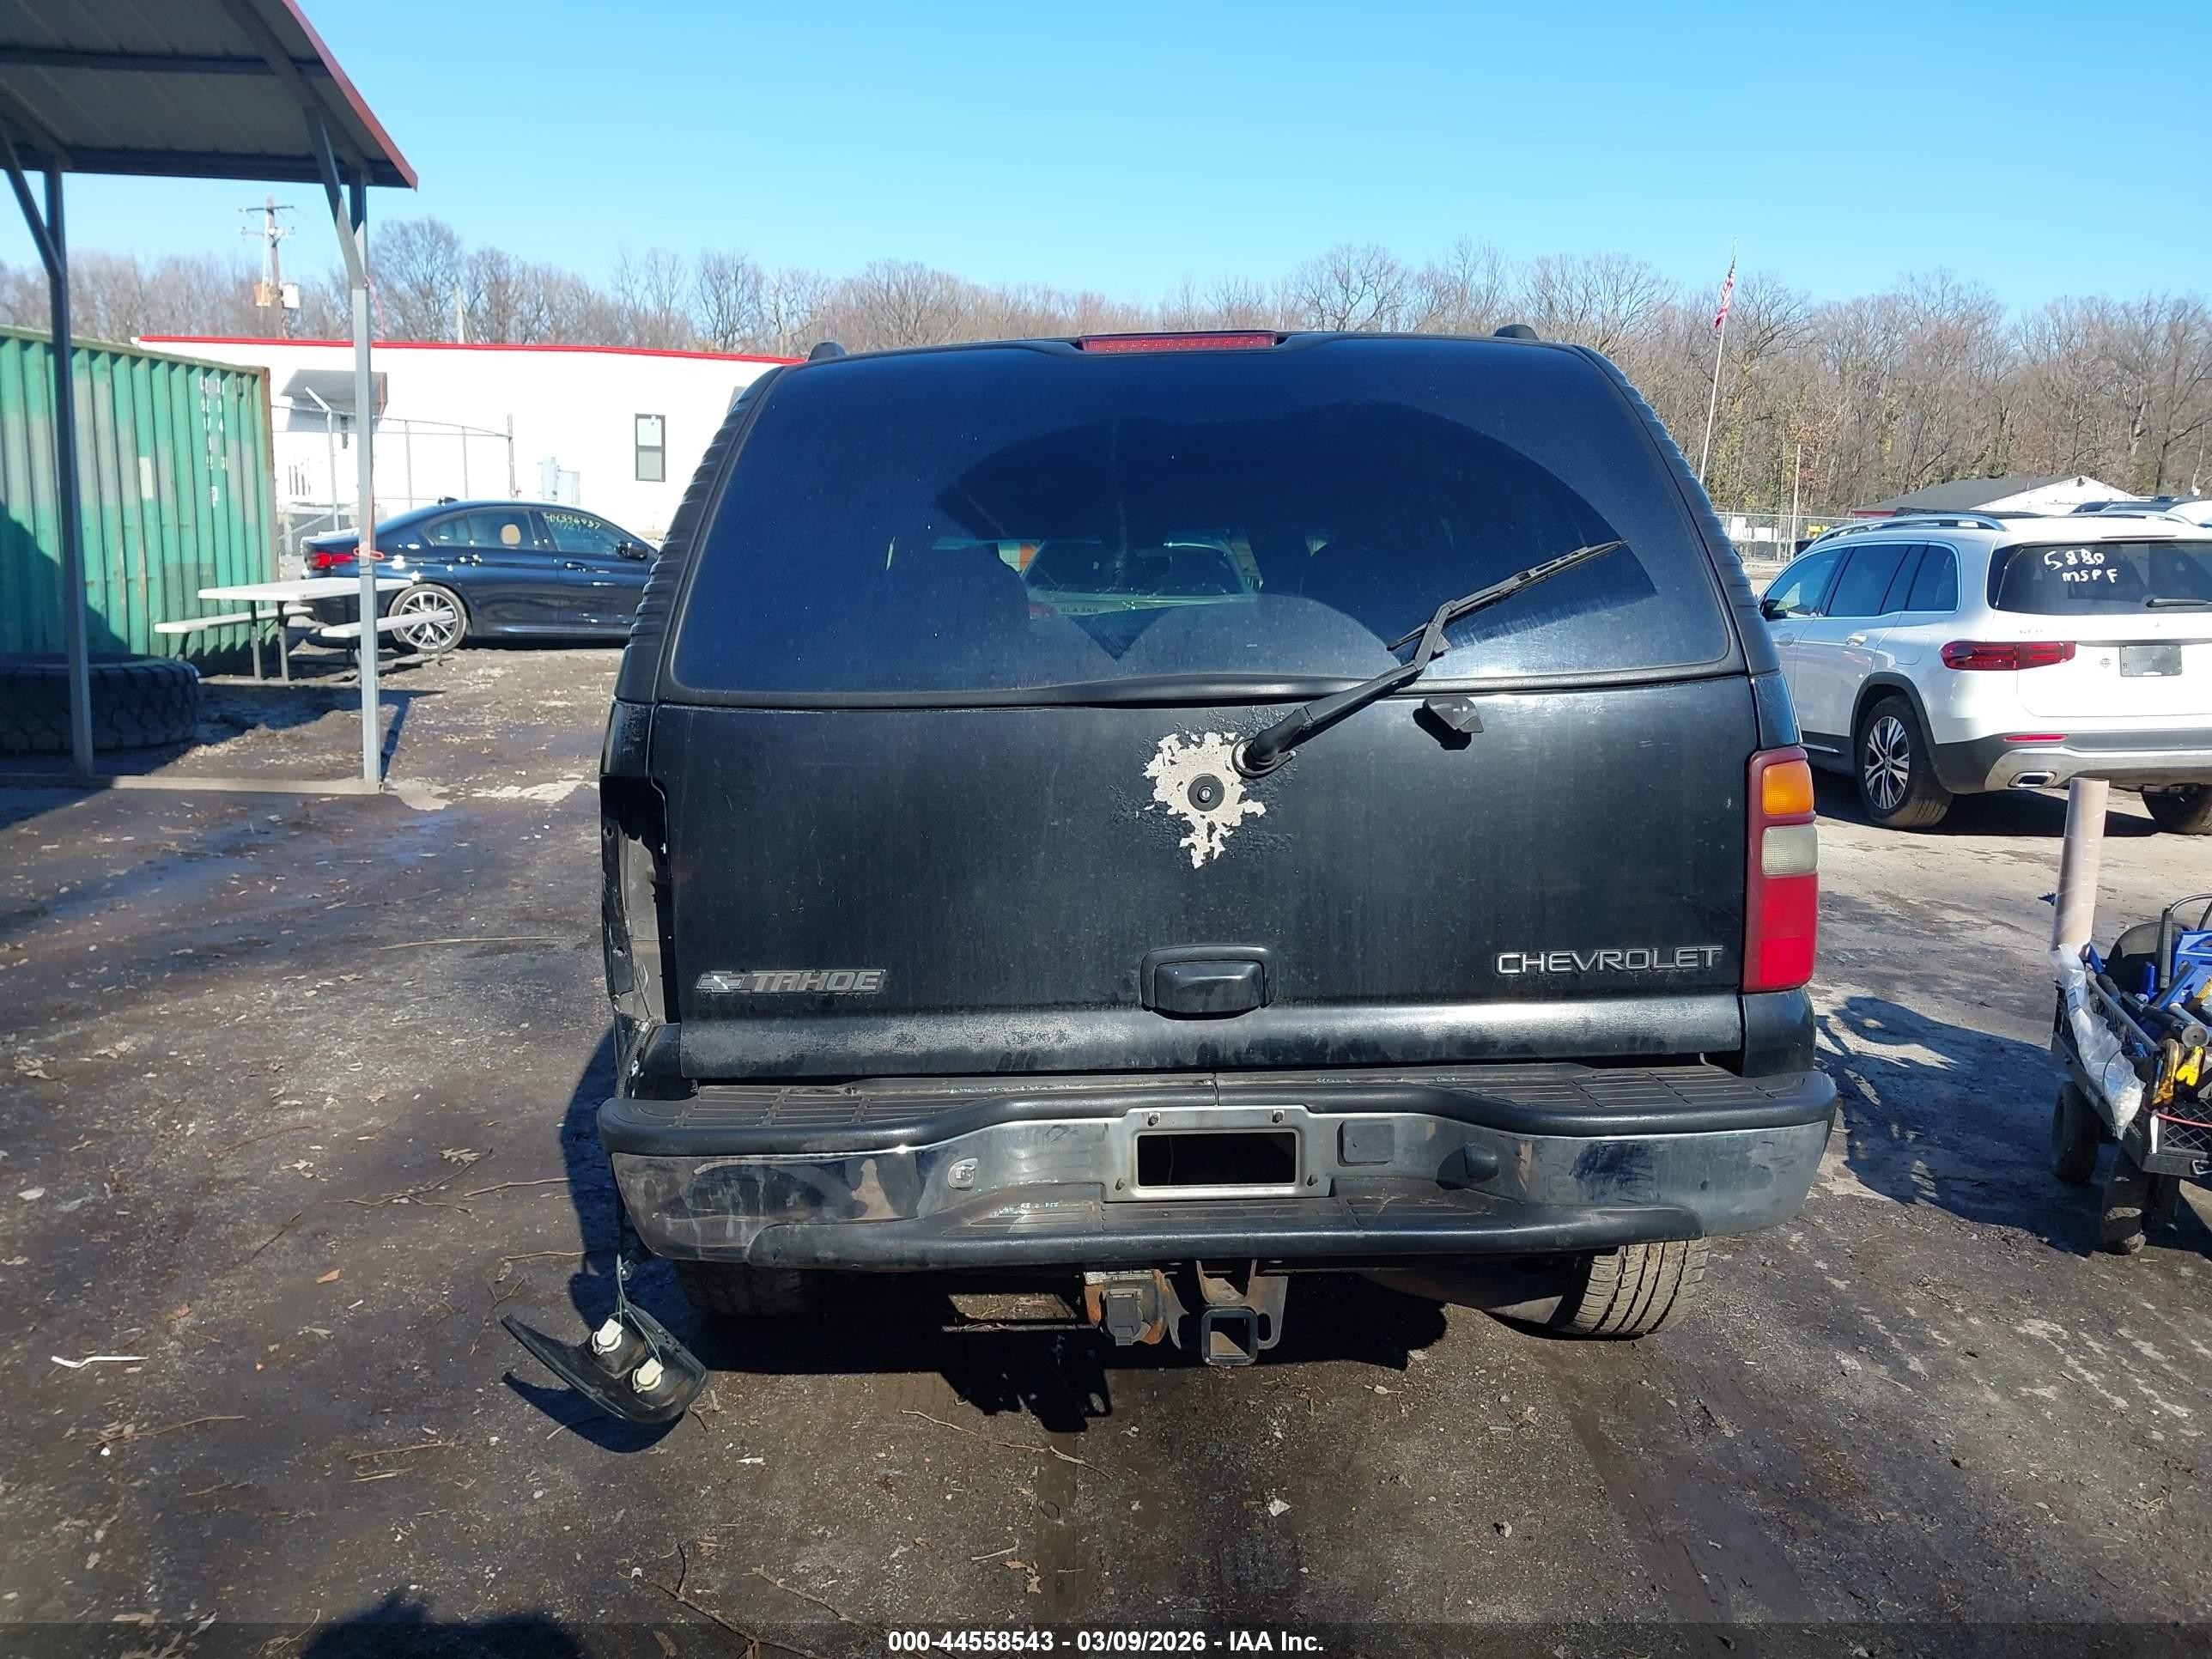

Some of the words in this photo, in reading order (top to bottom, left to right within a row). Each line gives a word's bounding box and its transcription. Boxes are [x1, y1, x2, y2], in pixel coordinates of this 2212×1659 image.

[2044, 548, 2105, 570] 5880
[1497, 945, 1723, 974] CHEVROLET
[751, 970, 884, 992] TAHOE
